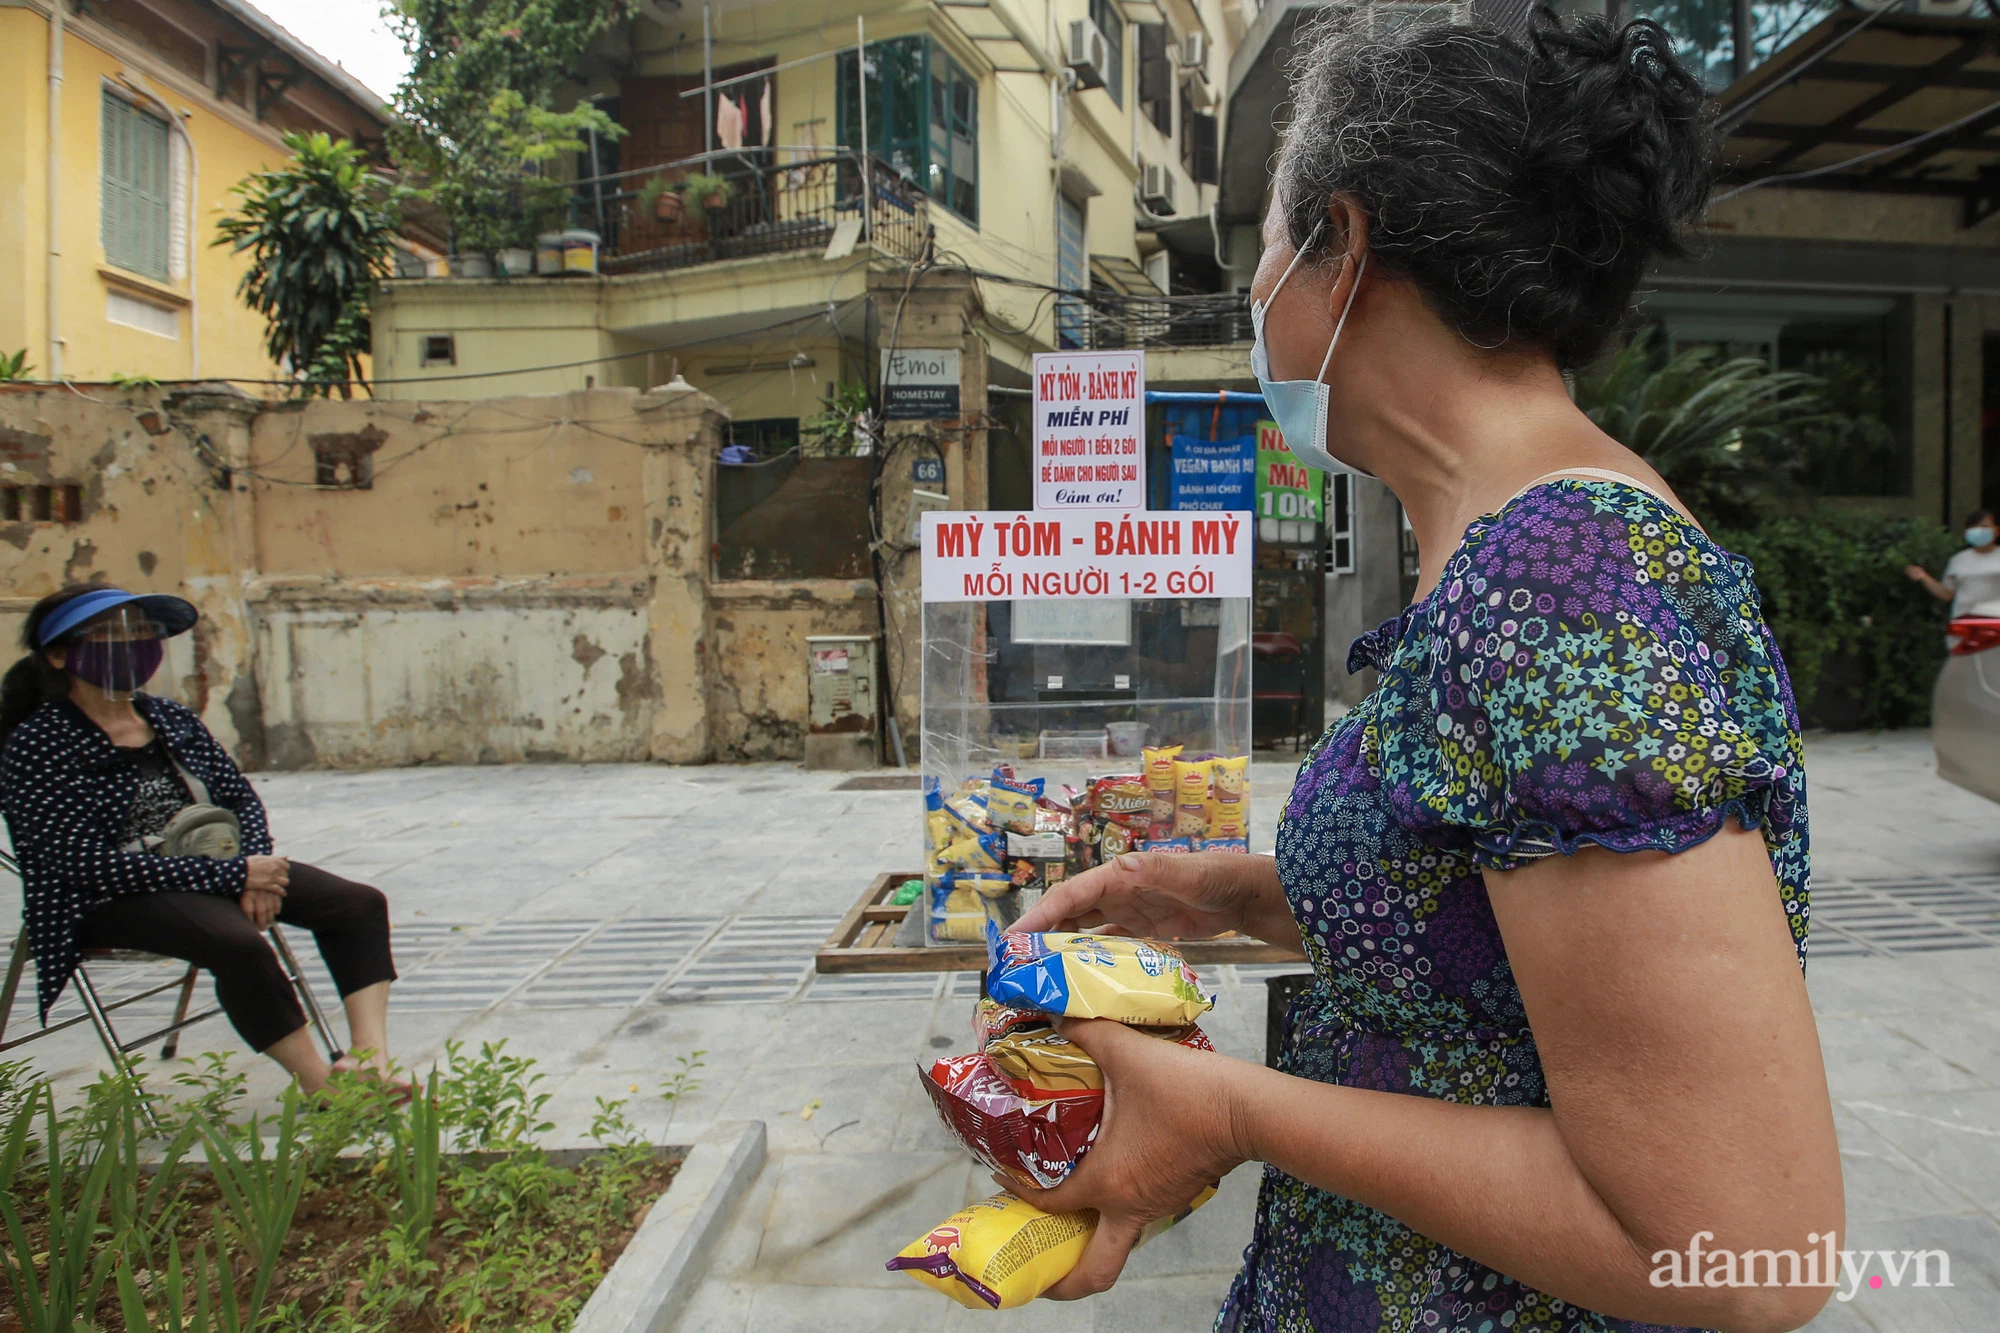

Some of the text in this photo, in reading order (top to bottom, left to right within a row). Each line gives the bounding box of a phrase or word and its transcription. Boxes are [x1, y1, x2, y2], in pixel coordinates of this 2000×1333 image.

[891, 355, 945, 377] Emoi
[1040, 364, 1056, 402] MỲ
[1058, 363, 1081, 401] TÔM
[1088, 362, 1118, 400] BÁNH
[892, 390, 946, 399] HOMESTAY
[1047, 405, 1130, 427] MIỄN PHÍ
[1060, 435, 1085, 456] NGƯỜI
[1088, 440, 1092, 455] 1
[1095, 433, 1112, 455] ĐẾN
[1114, 438, 1120, 454] 2
[1122, 435, 1136, 454] GÓI
[1054, 463, 1075, 482] DÀNH
[1078, 466, 1093, 481] CHO
[1095, 461, 1119, 481] NGƯỜI
[1121, 465, 1137, 481] SAU
[1174, 458, 1208, 474] VEGAN
[1269, 461, 1310, 490] MÍA
[1218, 485, 1242, 494] CHAY
[937, 515, 984, 557] MỲ
[993, 515, 1061, 557] TÔM
[1095, 513, 1180, 556] BÁNH
[1192, 513, 1239, 555] MỲ
[964, 562, 1214, 596] MỖI NGƯỜI 1-2 GÓI
